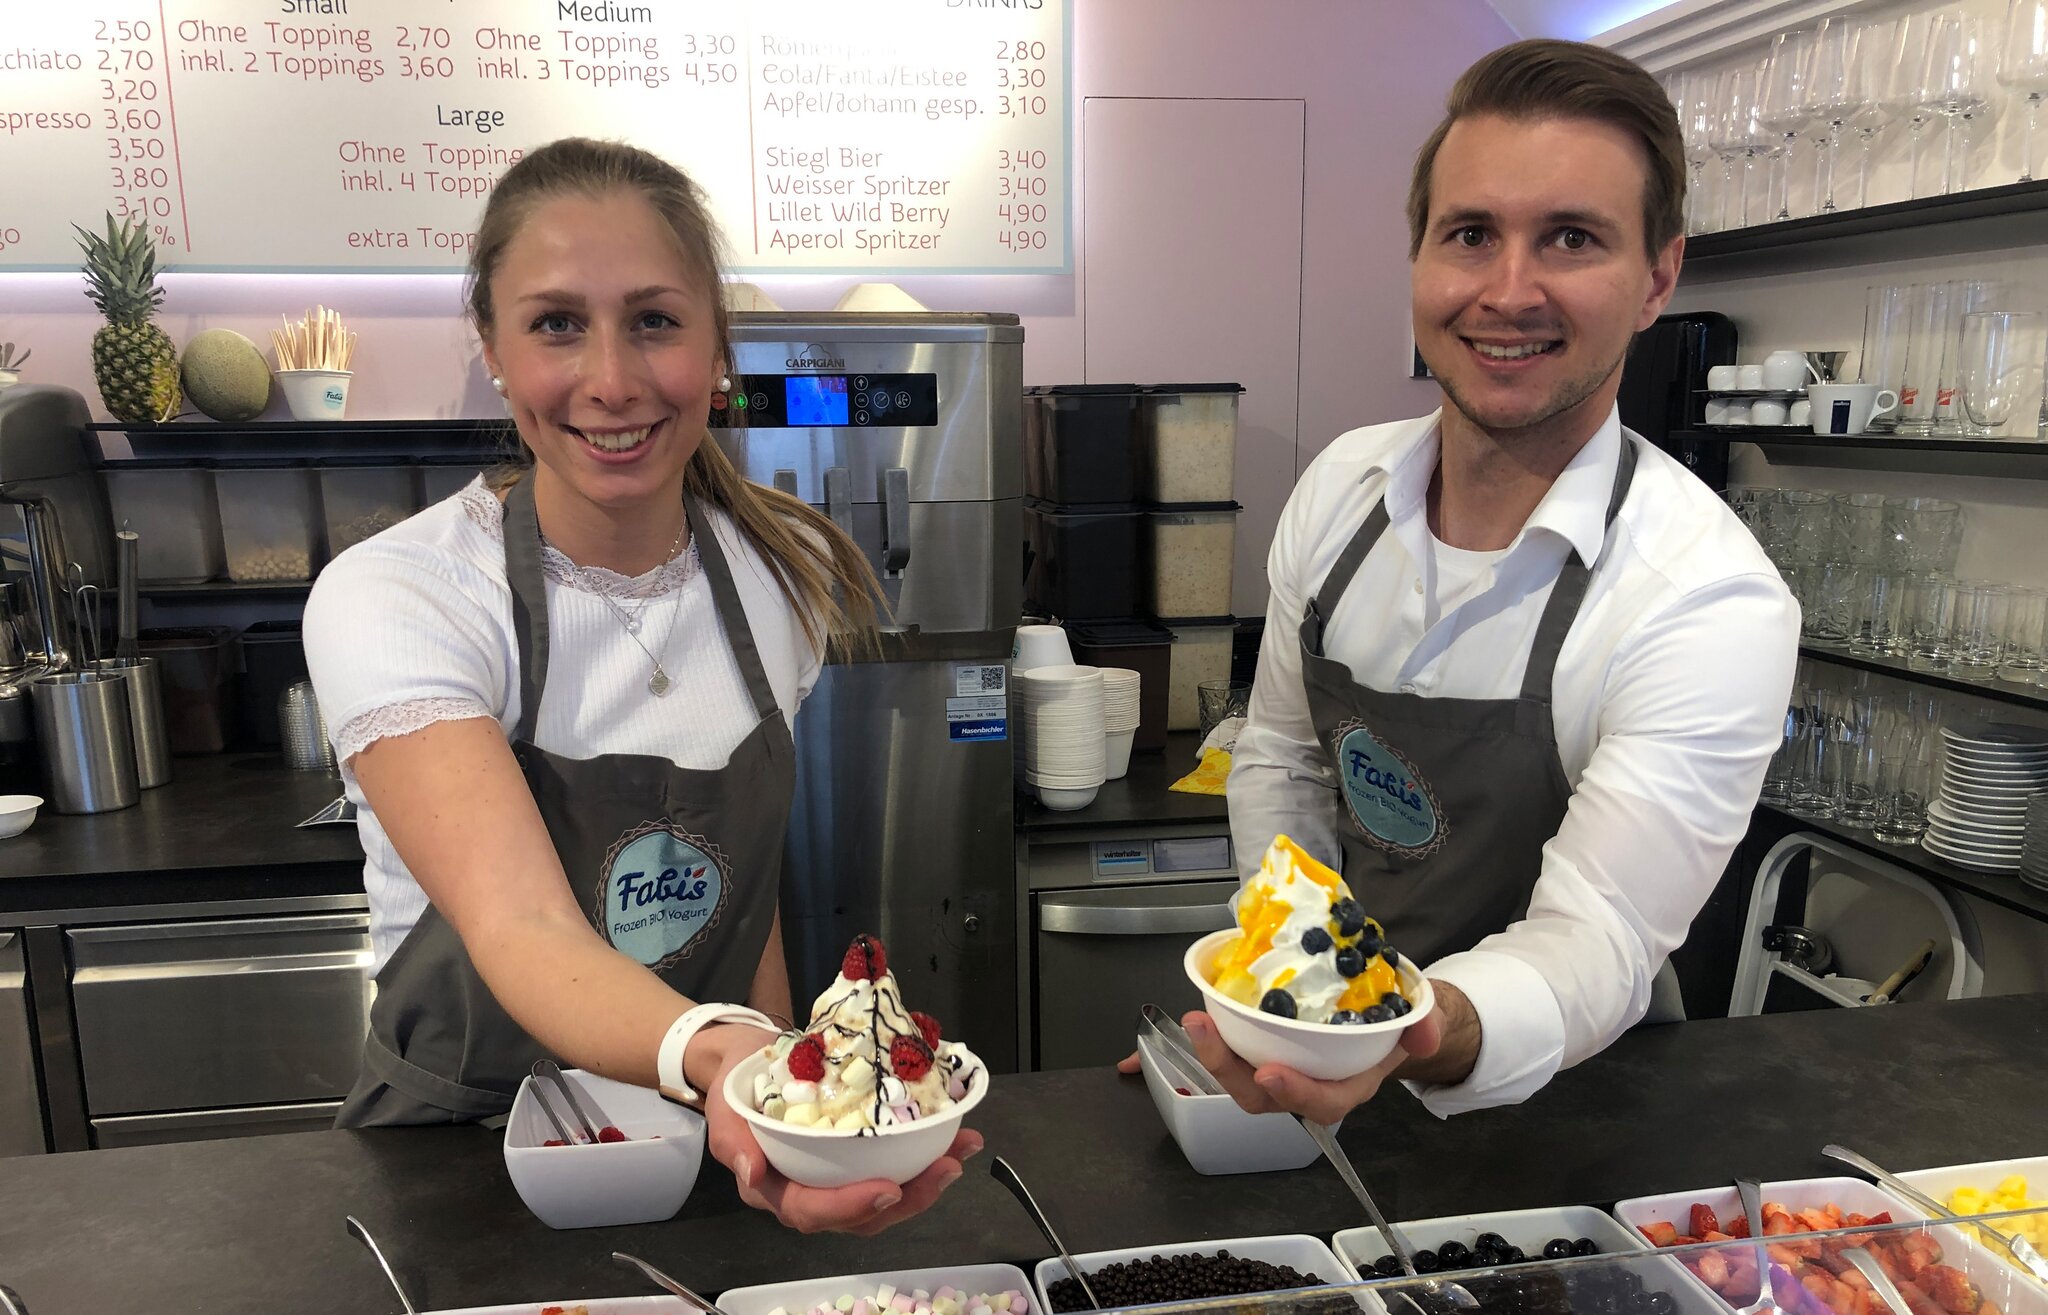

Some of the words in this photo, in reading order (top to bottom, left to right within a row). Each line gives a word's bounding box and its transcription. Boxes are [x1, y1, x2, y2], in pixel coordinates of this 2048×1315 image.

[558, 0, 652, 23] Medium
[94, 19, 151, 45] 2,50
[178, 19, 248, 44] Ohne
[264, 22, 372, 53] Topping
[396, 26, 451, 52] 2,70
[475, 27, 542, 51] Ohne
[558, 30, 659, 60] Topping
[684, 34, 735, 58] 3,30
[98, 49, 154, 74] 2,70
[996, 40, 1046, 63] 2,80
[181, 49, 234, 73] inkl.
[244, 52, 259, 73] 2
[266, 52, 385, 83] Toppings
[398, 55, 454, 81] 3,60
[478, 57, 528, 80] inkl.
[537, 59, 551, 80] 3
[558, 59, 670, 89] Toppings
[685, 63, 738, 86] 4,50
[100, 79, 157, 104] 3,20
[997, 68, 1047, 91] 3,30
[763, 91, 917, 118] Apfel/Johann
[924, 98, 985, 120] gesp.
[998, 95, 1047, 119] 3,10
[103, 108, 162, 133] 3,60
[437, 104, 505, 134] Large
[107, 138, 165, 163] 3,50
[339, 140, 407, 163] Ohne
[766, 146, 830, 174] Stiegl
[838, 147, 883, 168] Bier
[998, 149, 1047, 173] 3,40
[111, 167, 168, 192] 3,80
[341, 169, 393, 192] inkl.
[400, 172, 415, 192] 4
[766, 174, 855, 195] Weisser
[863, 175, 951, 201] Spritzer
[998, 177, 1047, 200] 3,40
[114, 196, 171, 221] 3,10
[768, 201, 824, 222] Lillet
[831, 201, 882, 222] Wild
[890, 202, 950, 229] Berry
[998, 203, 1047, 227] 4,90
[347, 228, 409, 248] extra
[769, 229, 844, 255] Aperol
[854, 229, 942, 256] Spritzer
[998, 230, 1047, 253] 4,90
[785, 358, 845, 368] CARPIGIANI
[1348, 781, 1376, 802] Frozen
[1349, 749, 1421, 811] Fabis
[616, 866, 708, 912] Fabis
[613, 916, 648, 936] Frozen
[649, 909, 666, 926] BIO
[667, 907, 709, 921] Yogurt
